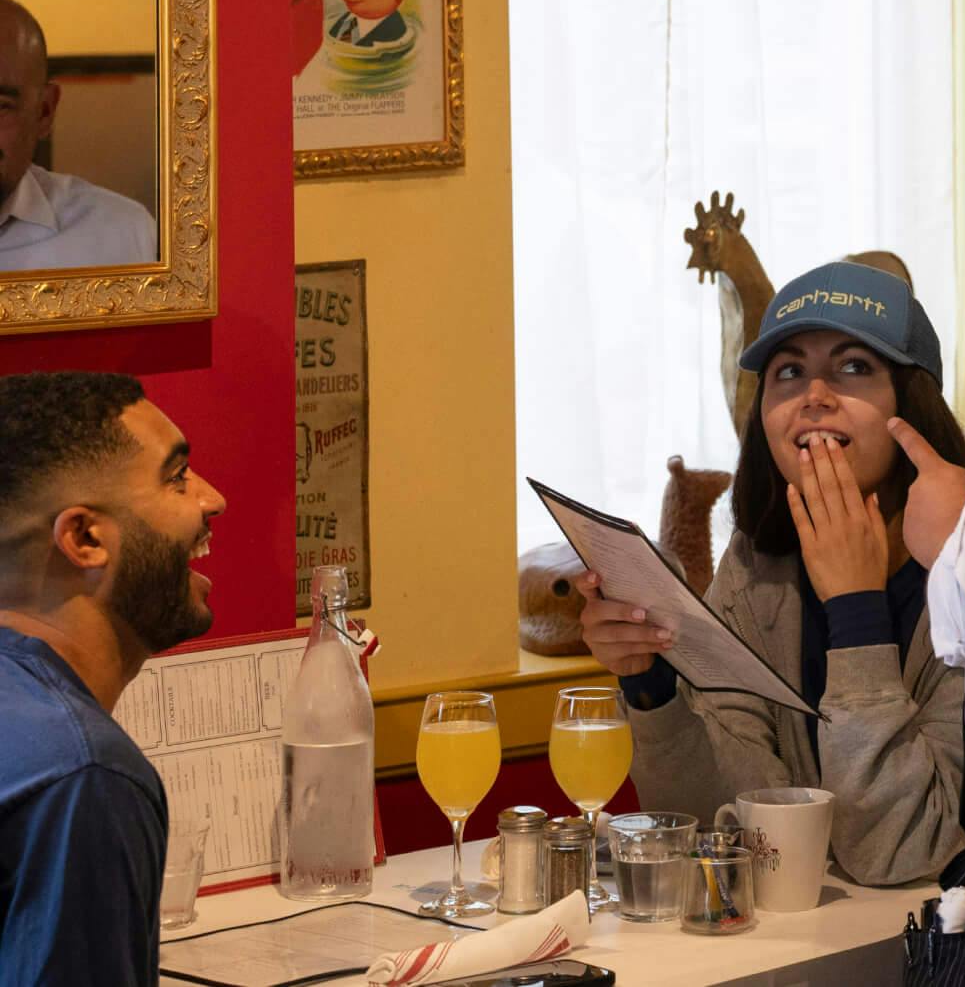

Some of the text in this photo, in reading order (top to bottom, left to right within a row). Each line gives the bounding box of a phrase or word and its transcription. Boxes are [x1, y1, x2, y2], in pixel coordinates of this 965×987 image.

[299, 94, 332, 104] KENNEDY
[327, 103, 341, 111] THE
[775, 289, 886, 319] carhartt
[314, 418, 357, 456] RUFFEC
[167, 686, 177, 728] COCKTAILS
